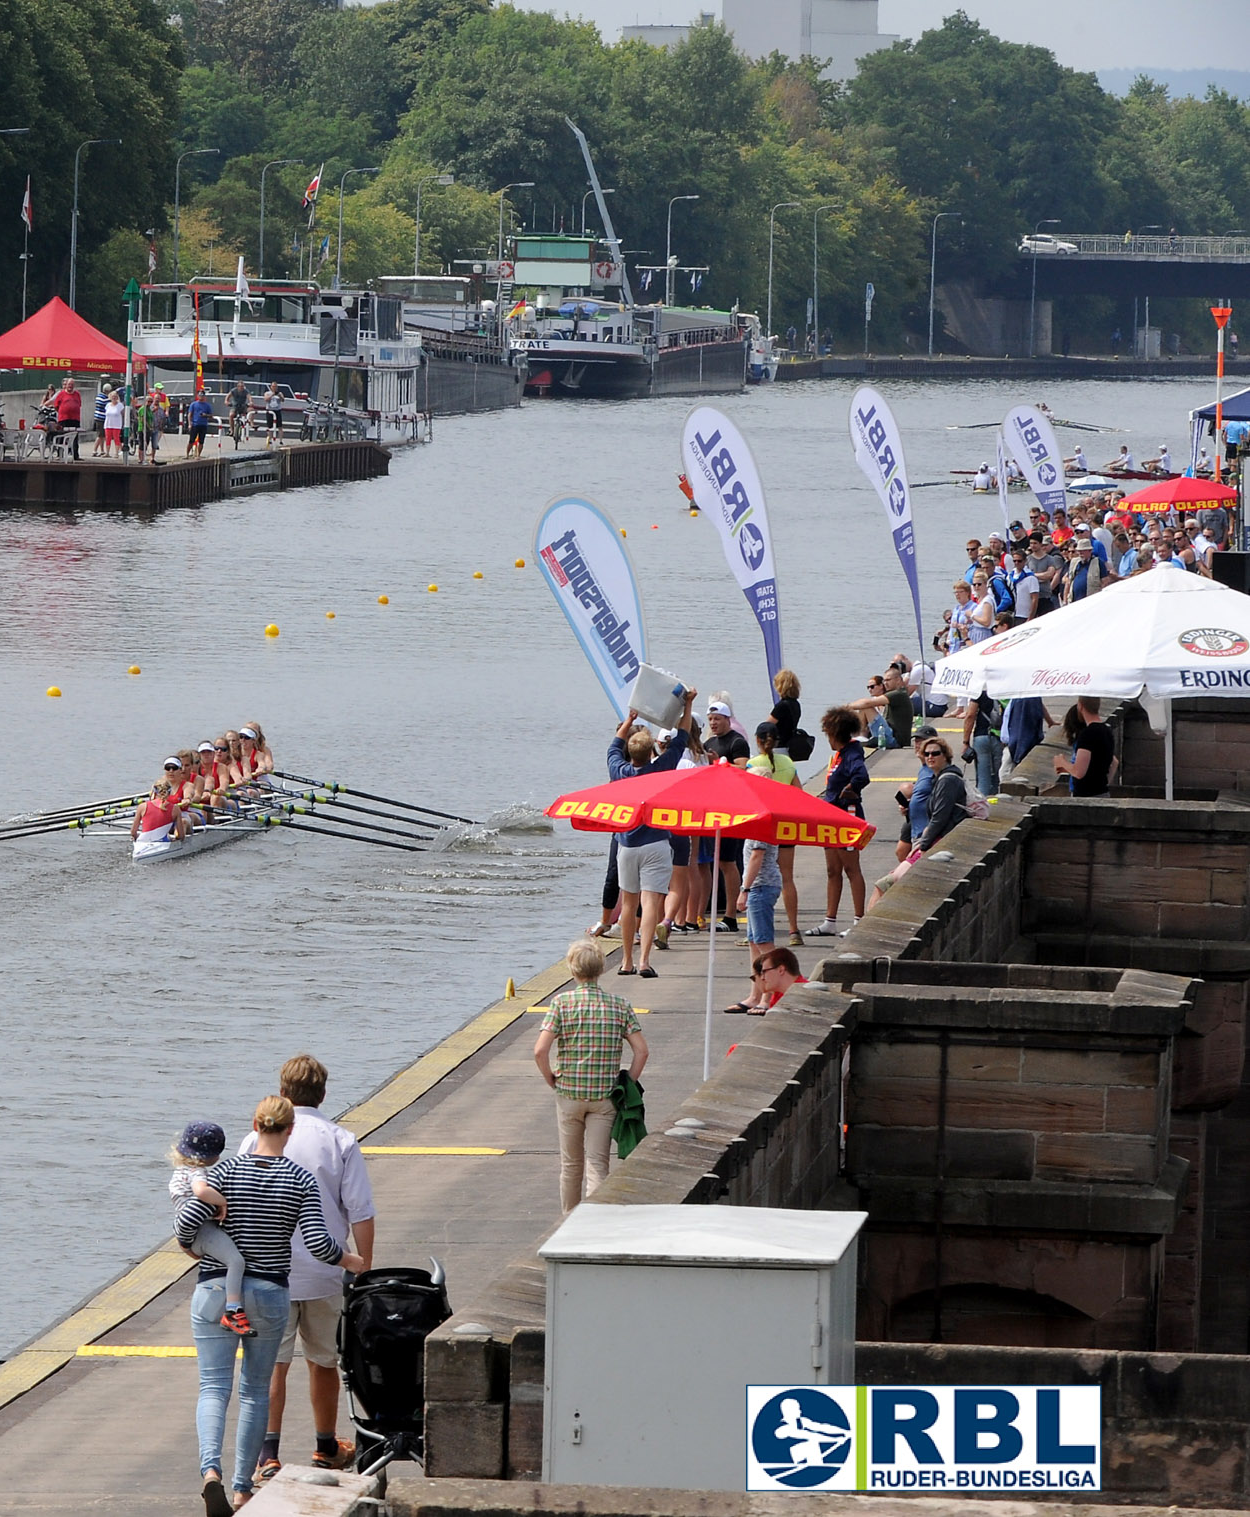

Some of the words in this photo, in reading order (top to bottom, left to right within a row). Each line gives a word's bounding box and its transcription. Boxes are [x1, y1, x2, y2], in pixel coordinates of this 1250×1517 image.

[510, 340, 550, 349] TRATE
[22, 357, 71, 367] DLRG
[86, 362, 113, 370] Minden
[1132, 502, 1168, 512] DLRG
[1175, 500, 1219, 510] DLRG
[1223, 499, 1236, 508] DL
[1181, 629, 1241, 642] ERDINGER
[939, 666, 973, 689] ERDINGER
[1032, 668, 1092, 689] Weißbier
[555, 801, 635, 824] DLRG
[651, 808, 759, 827] DLRG
[776, 821, 862, 844] DLRG
